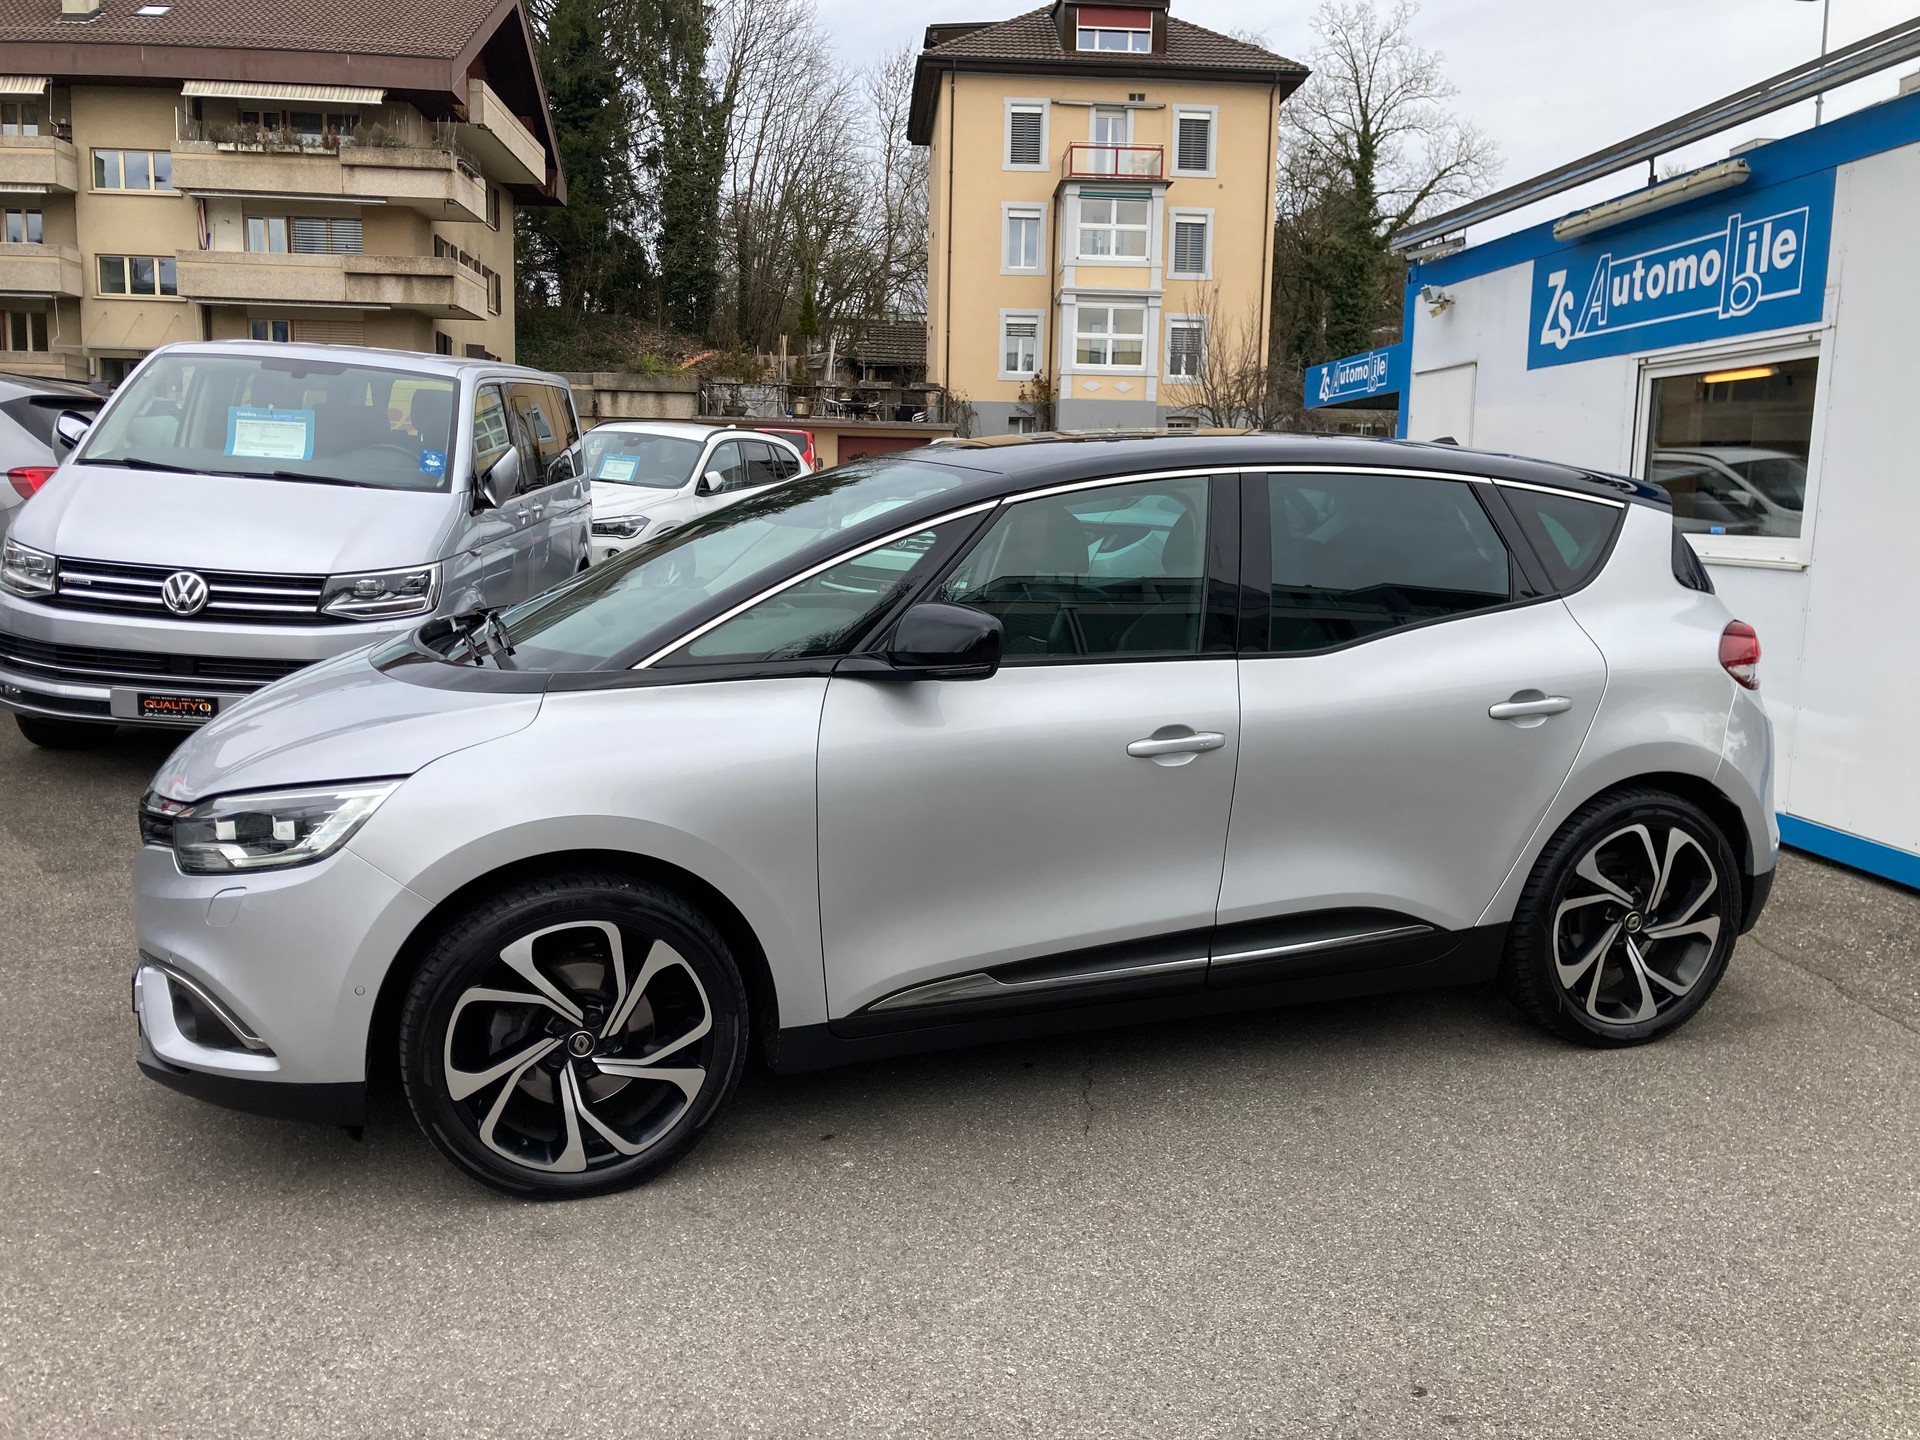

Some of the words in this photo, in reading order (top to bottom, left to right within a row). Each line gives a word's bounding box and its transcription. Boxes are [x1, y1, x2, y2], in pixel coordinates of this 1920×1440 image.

[1575, 213, 1797, 335] Automobile
[1330, 352, 1386, 396] Automobile
[144, 700, 198, 710] QUALITY
